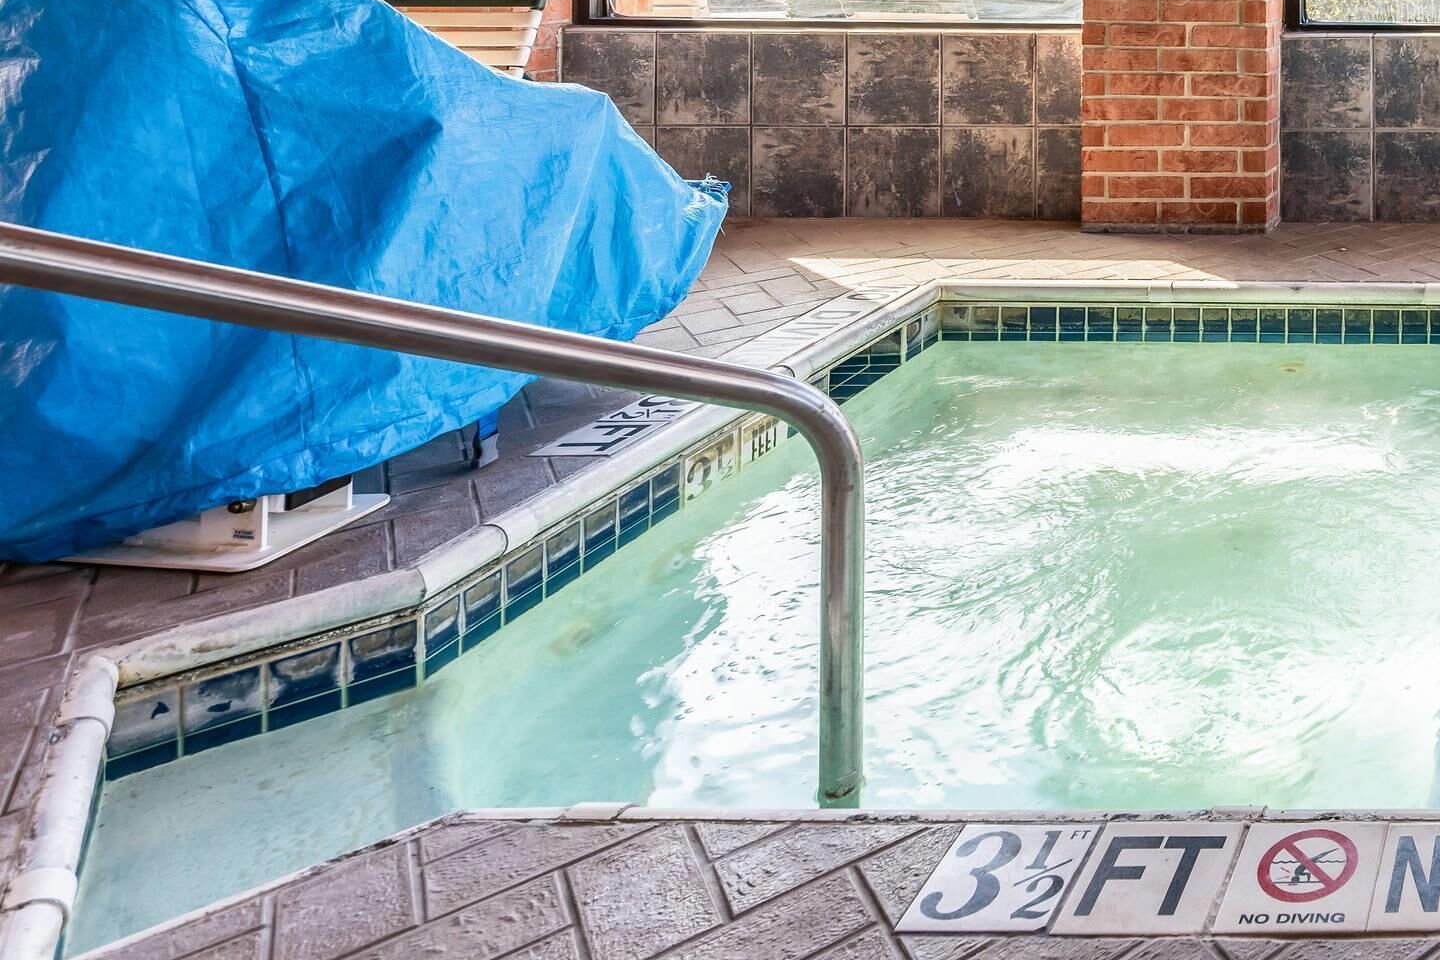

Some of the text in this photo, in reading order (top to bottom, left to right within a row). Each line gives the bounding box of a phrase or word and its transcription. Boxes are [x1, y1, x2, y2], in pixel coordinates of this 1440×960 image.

[556, 424, 652, 452] FT
[1070, 830, 1091, 840] FT
[1073, 836, 1227, 917] FT
[1238, 913, 1346, 925] NO DIVING
